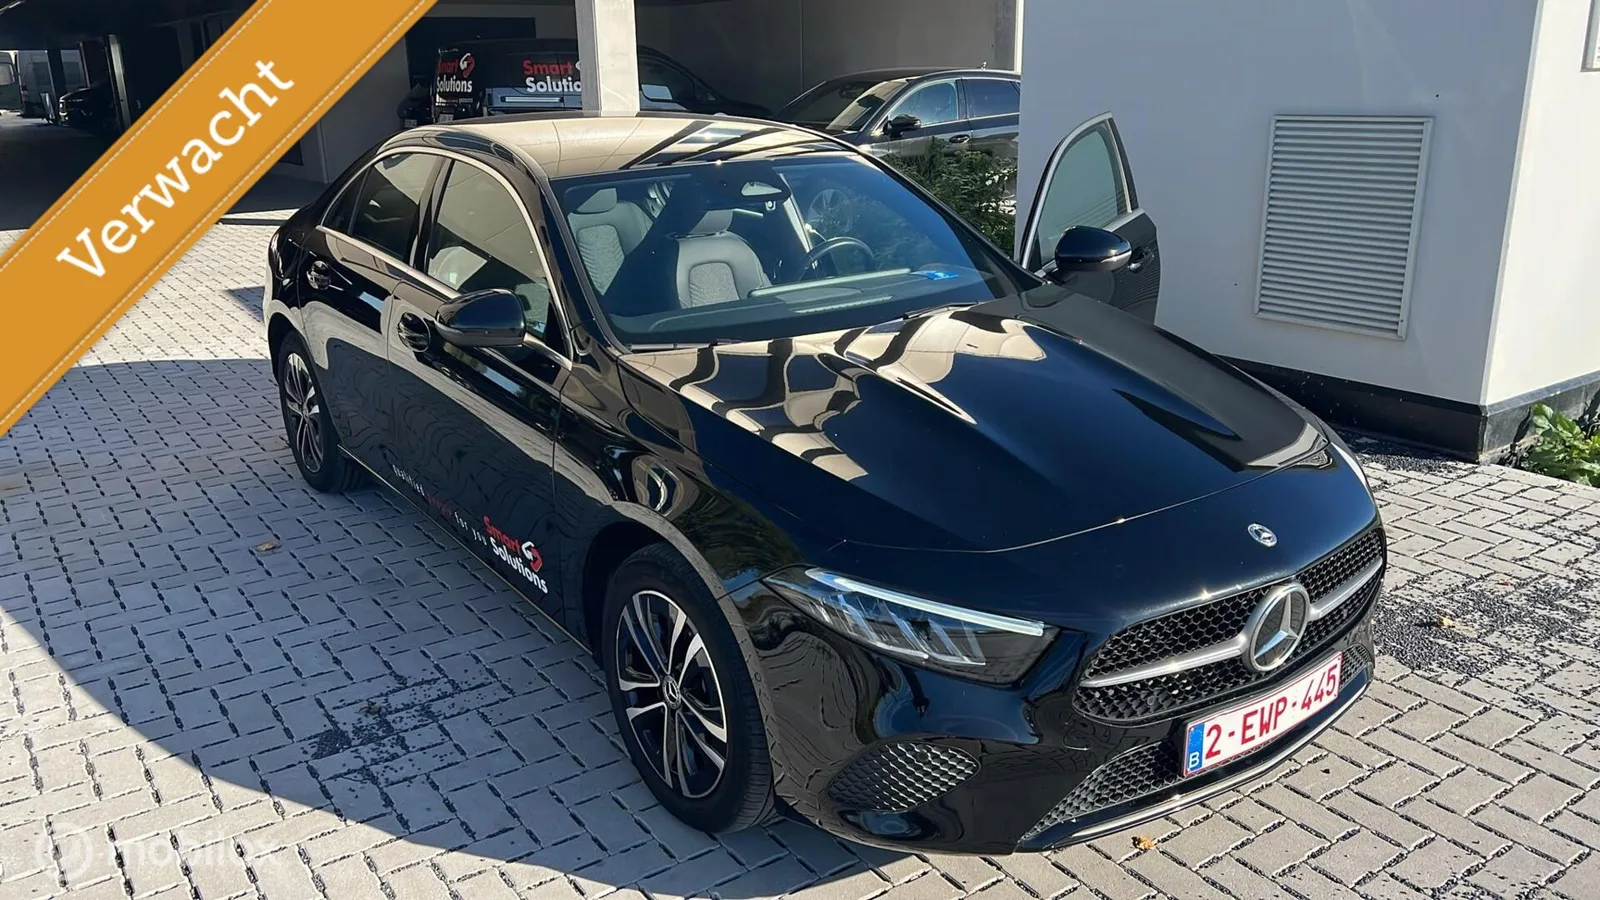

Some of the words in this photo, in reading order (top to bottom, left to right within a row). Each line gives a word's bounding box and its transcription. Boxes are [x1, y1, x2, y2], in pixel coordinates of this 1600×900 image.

[436, 74, 473, 93] Solutions
[523, 60, 573, 76] Smart
[484, 515, 522, 558] Smart
[490, 536, 548, 594] Solutions
[1205, 663, 1338, 760] 2-EWP-445
[1188, 751, 1200, 769] B
